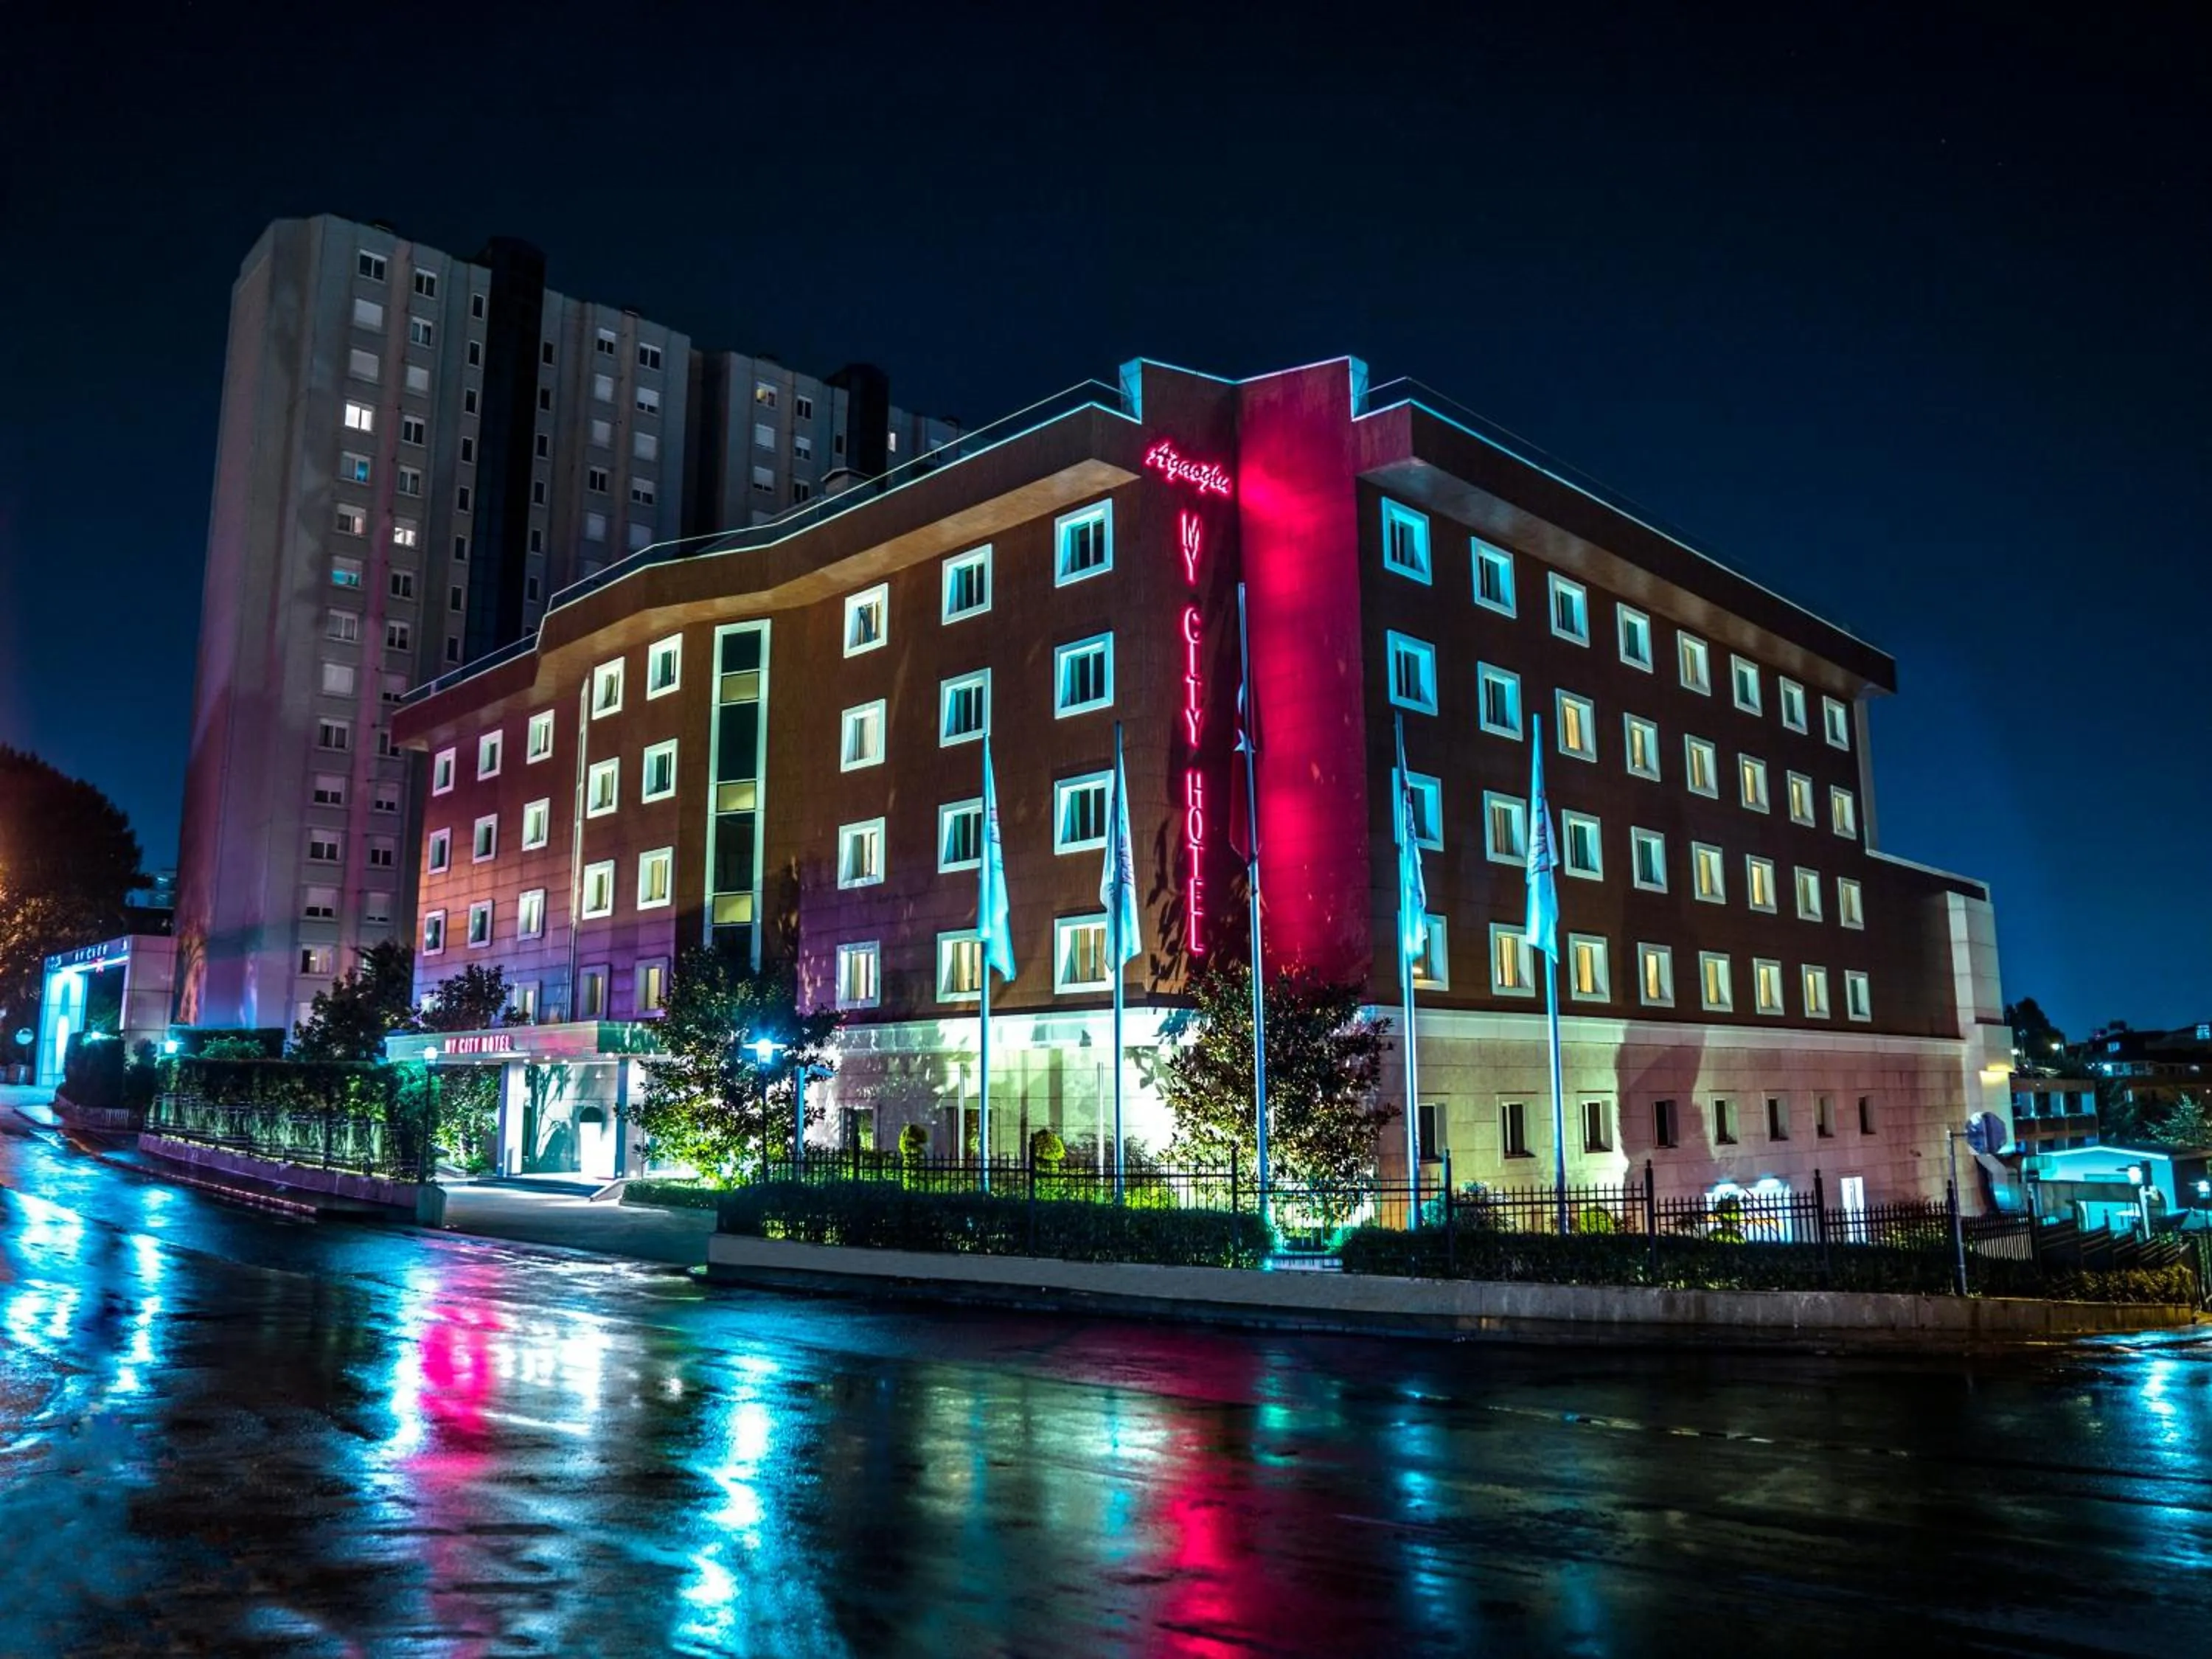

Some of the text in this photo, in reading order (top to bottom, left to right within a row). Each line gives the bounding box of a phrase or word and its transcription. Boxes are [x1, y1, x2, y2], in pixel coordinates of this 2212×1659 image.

[1183, 607, 1203, 745] CITY
[1186, 771, 1204, 952] HOTEL
[459, 1037, 481, 1054] CITY
[481, 1034, 510, 1053] HOTEL
